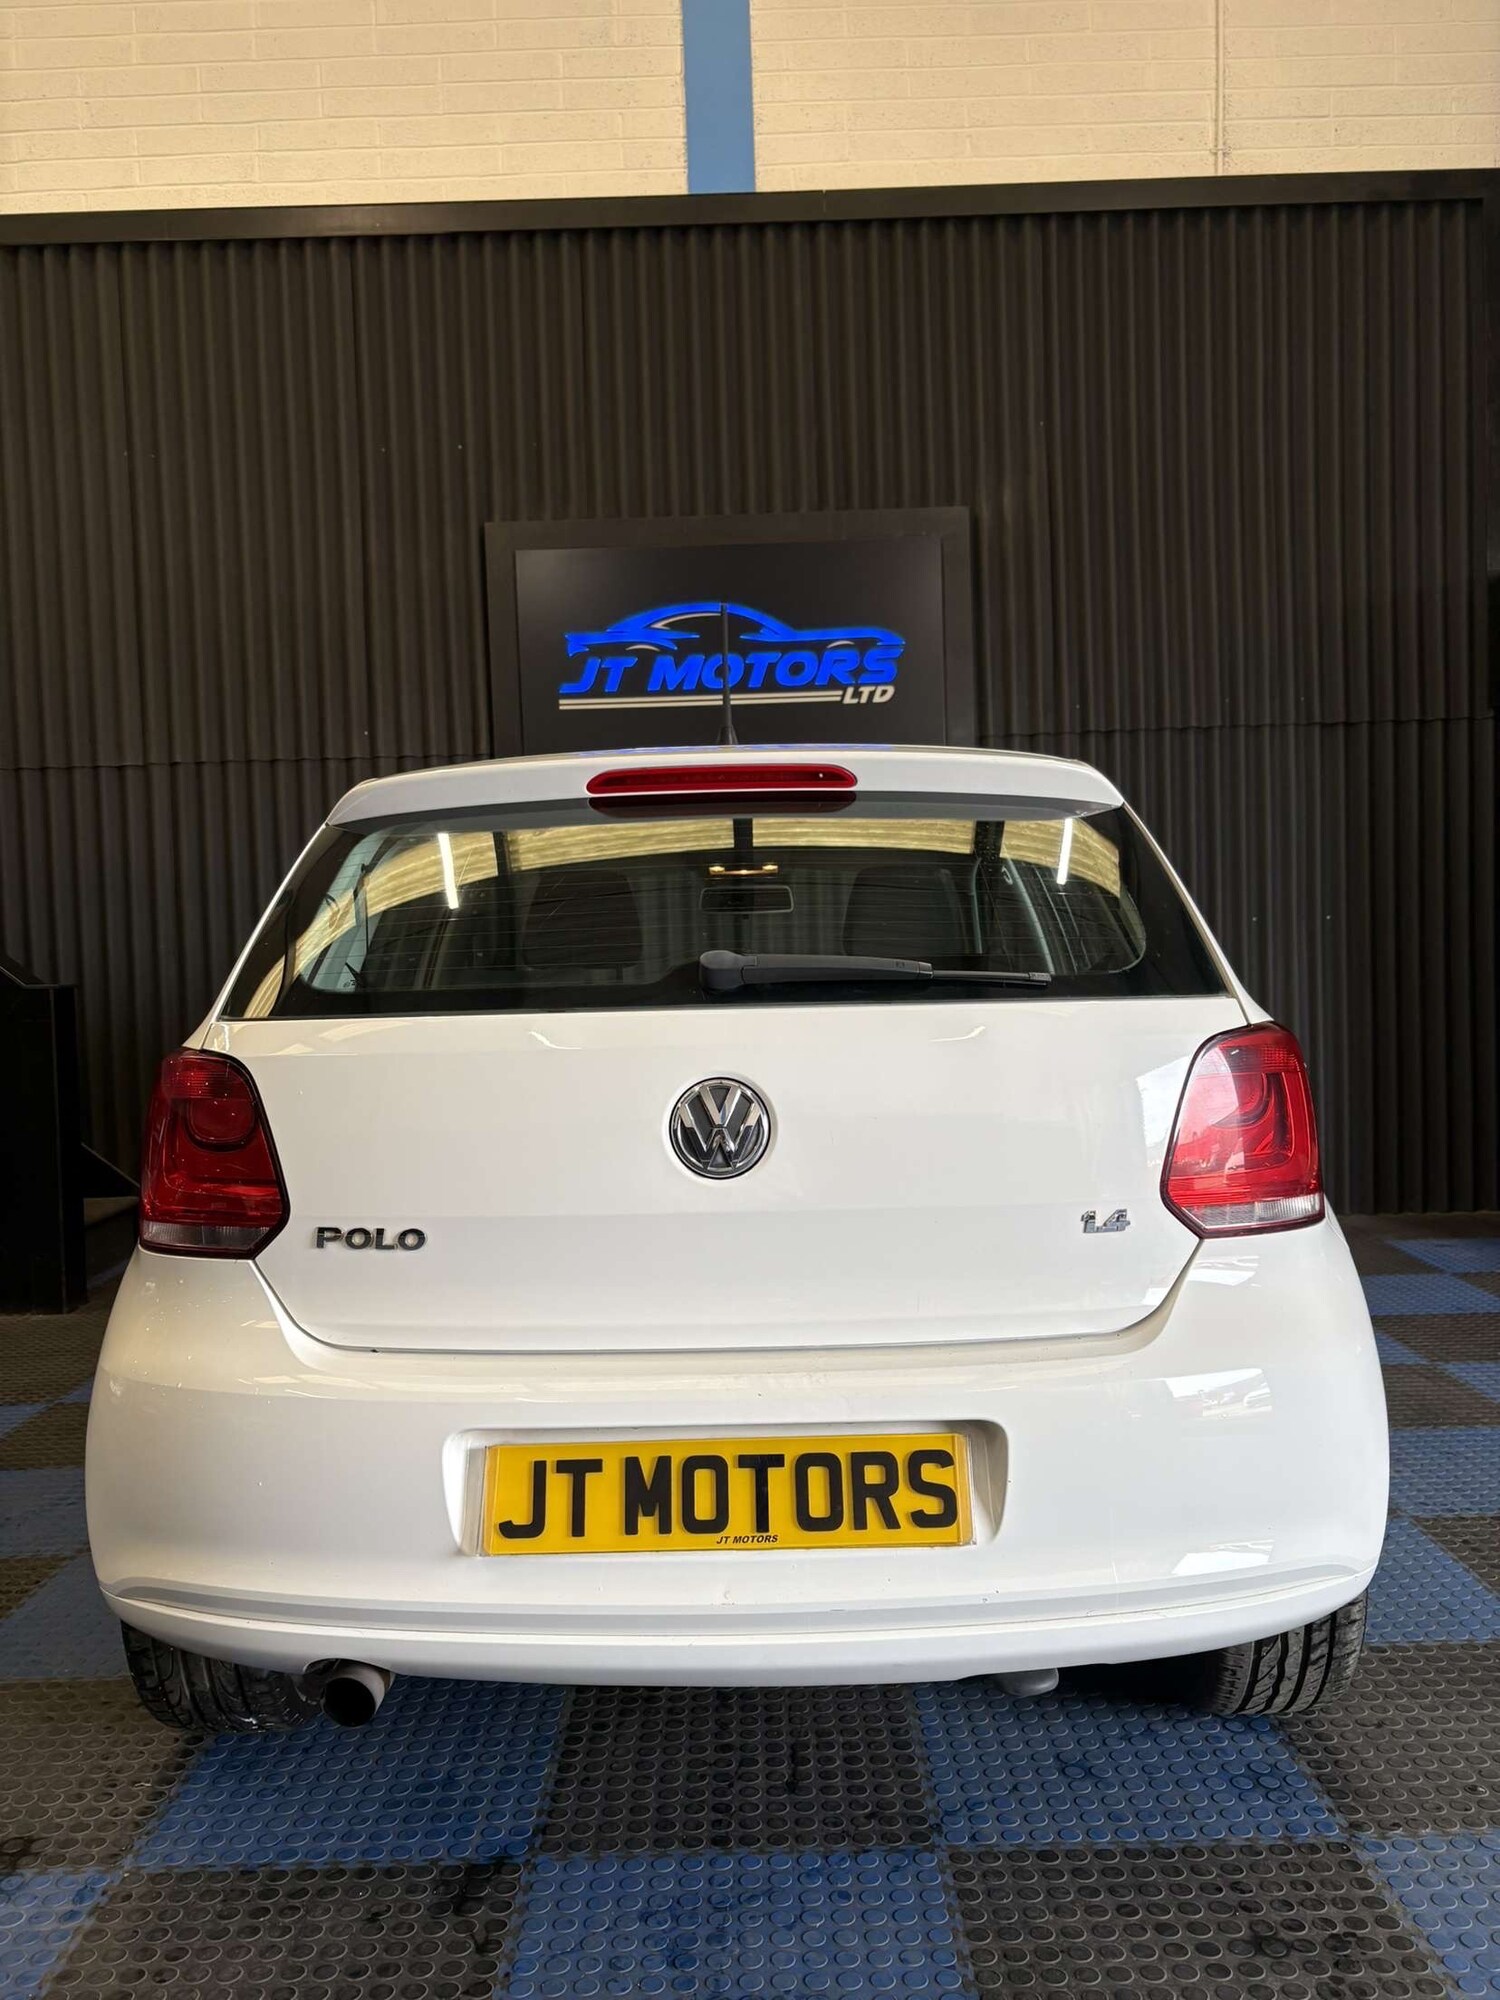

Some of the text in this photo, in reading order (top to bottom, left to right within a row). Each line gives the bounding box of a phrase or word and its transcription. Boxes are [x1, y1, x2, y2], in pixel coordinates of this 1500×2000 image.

[559, 647, 904, 693] JT MOTORS
[842, 685, 895, 704] LTD
[315, 1226, 427, 1251] POLO
[498, 1449, 959, 1539] JT MOTORS
[716, 1535, 778, 1545] JT MOTORS
